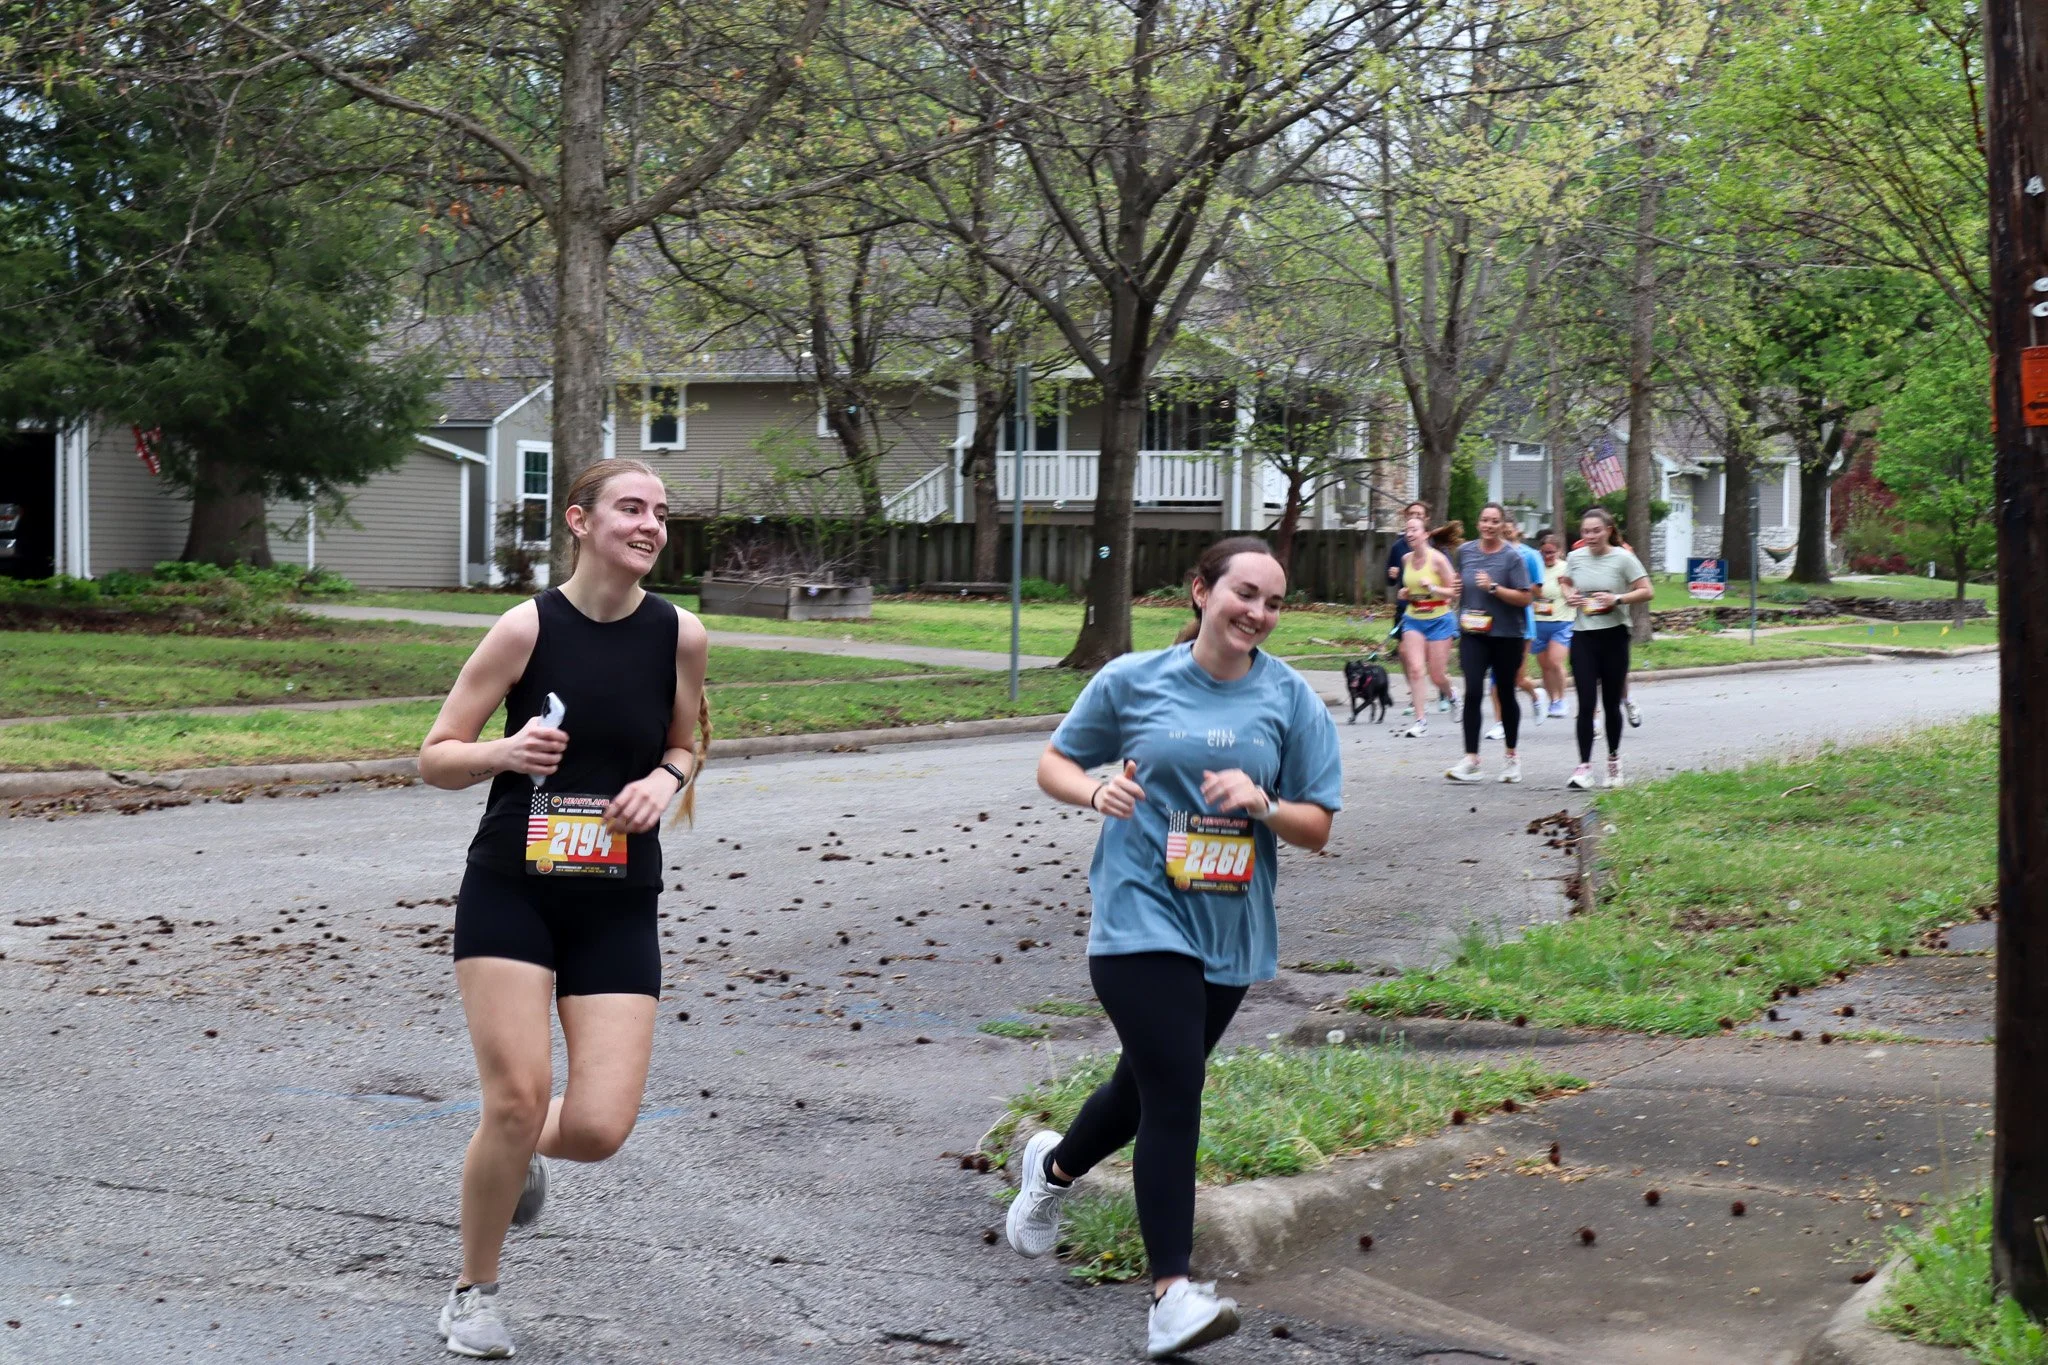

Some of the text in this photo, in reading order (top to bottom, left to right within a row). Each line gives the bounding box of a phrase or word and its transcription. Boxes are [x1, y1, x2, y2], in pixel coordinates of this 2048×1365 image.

[1207, 737, 1235, 748] CITY
[563, 797, 610, 807] HEARTLAND
[548, 822, 613, 857] 2194
[1184, 840, 1252, 876] 2268
